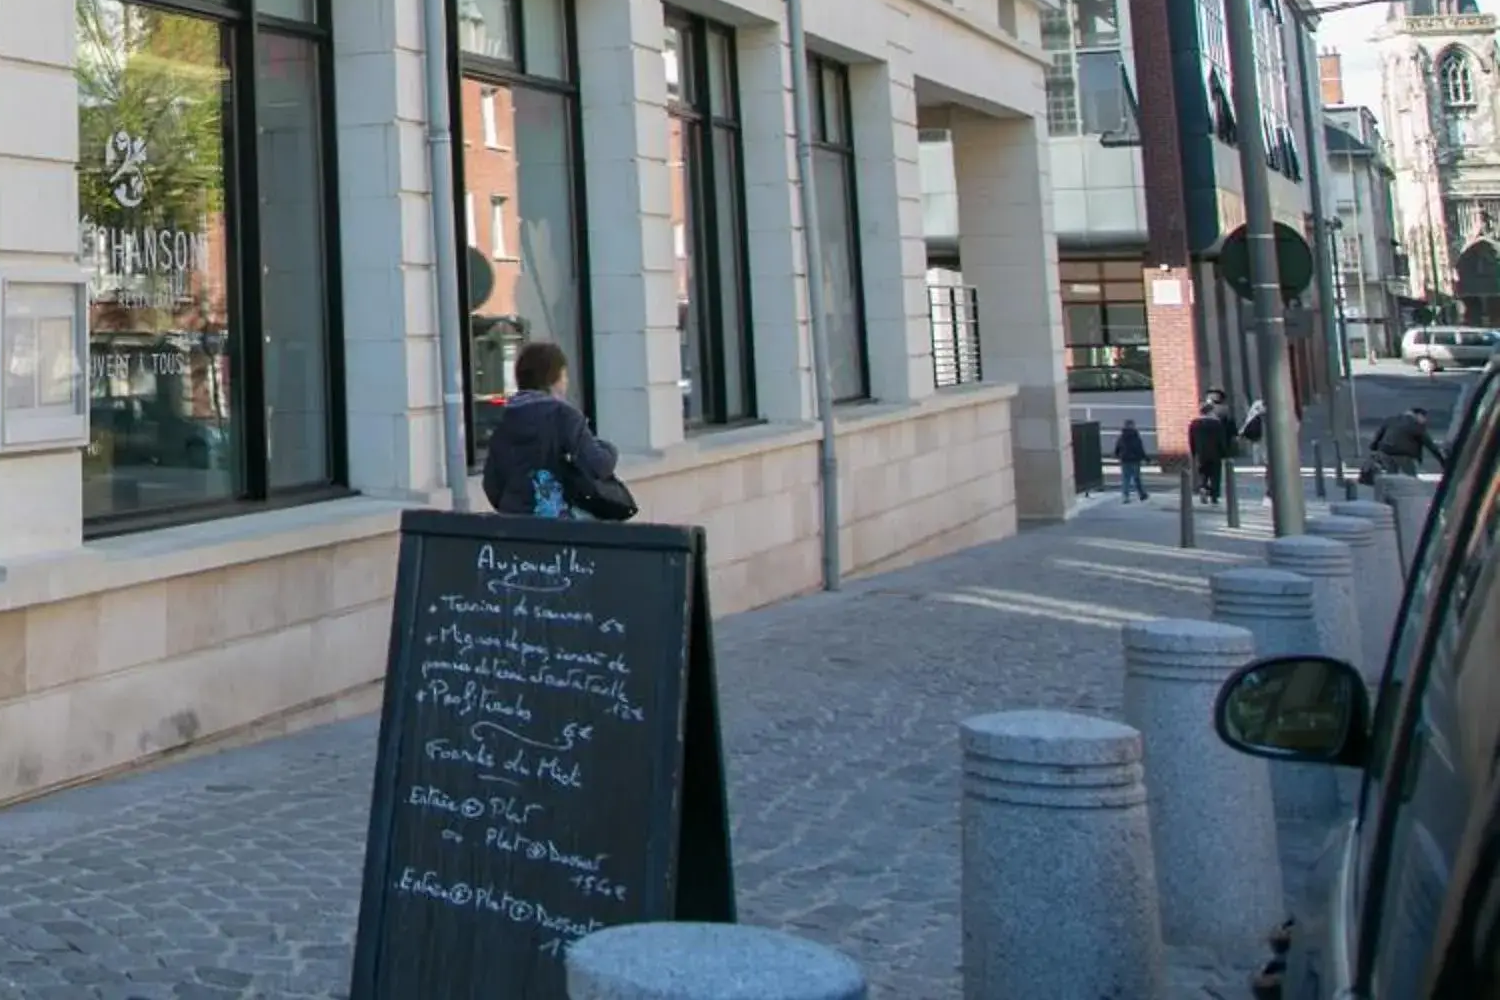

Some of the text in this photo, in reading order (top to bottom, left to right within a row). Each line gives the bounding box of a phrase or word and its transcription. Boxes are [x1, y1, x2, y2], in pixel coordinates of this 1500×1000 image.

[90, 353, 131, 377] UVERT
[151, 353, 185, 375] TOUS
[440, 595, 501, 614] Terrine
[489, 797, 545, 823] Plat
[485, 827, 531, 852] Plat
[474, 886, 516, 911] Plat
